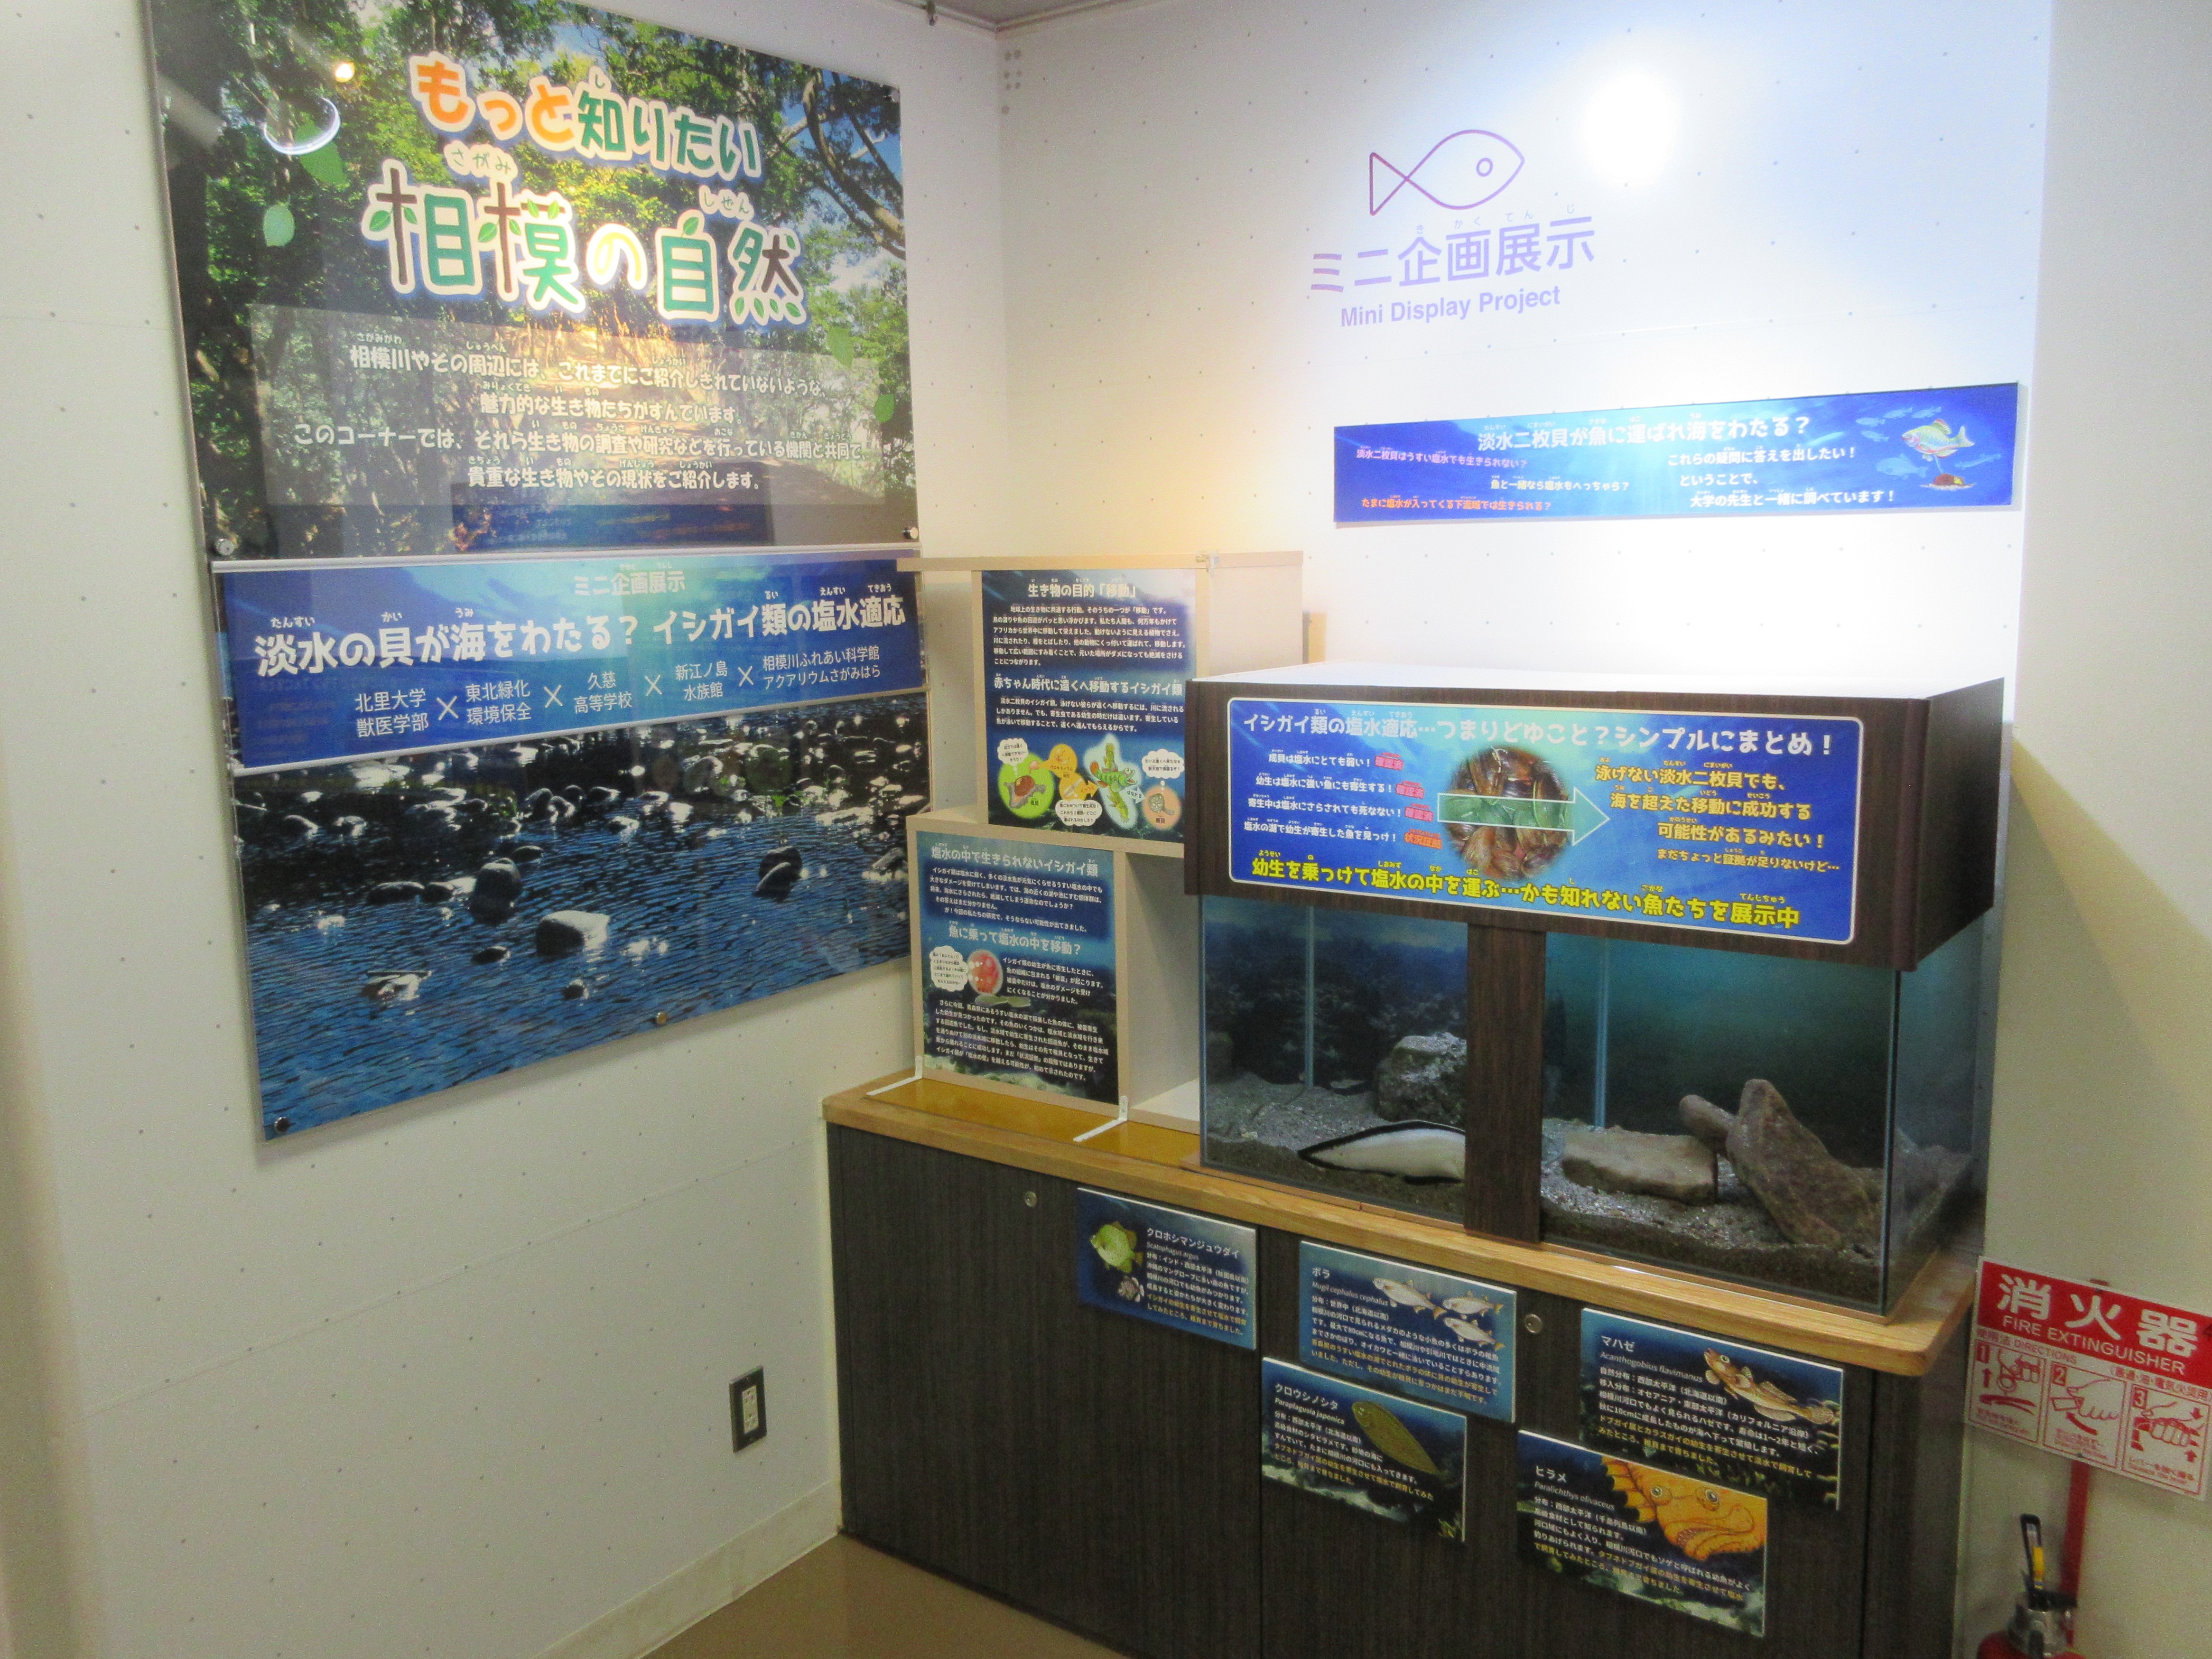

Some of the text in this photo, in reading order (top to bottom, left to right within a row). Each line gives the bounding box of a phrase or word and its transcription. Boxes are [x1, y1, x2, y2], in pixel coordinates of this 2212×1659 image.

[416, 60, 761, 176] もっと知りたい
[450, 146, 512, 173] さがみ
[704, 190, 751, 215] しぜん
[368, 167, 801, 320] 相模の自然
[1311, 216, 1595, 292] ミニ企画展示
[1341, 286, 1561, 327] Mini Display Project
[356, 332, 402, 343] さがみがわ
[465, 341, 506, 353] しゅうへん
[483, 381, 531, 392] みりょくてき
[481, 392, 743, 423] 魅力的な生き物たちがすんでいます。
[1478, 416, 1810, 452] 淡水二枚貝が魚に運ばれ海をわたる？
[1356, 448, 1527, 469] 淡水二枚貝はうすい塩水でも生きられない？
[1668, 447, 1856, 466] これらの疑問に答えを出したい！
[467, 466, 759, 490] 貴重な生き物やその現状をご紹介します。
[1491, 479, 1629, 492] 魚と一緒なら塩水もへっちゃら？
[1679, 473, 1758, 486] ということで、
[1690, 489, 1896, 507] 大学の先生と一緒に調べています！
[575, 570, 685, 596] ミニ企画展示
[1028, 583, 1136, 598] 生き物の目的「移動」
[271, 616, 316, 629] たんすい
[381, 611, 402, 623] かい
[456, 607, 474, 618] うみ
[254, 594, 906, 677] 淡水の貝が海をわたる？ イシガイ類の塩水適応
[355, 645, 880, 713] 北里大学 東北緑化 久慈 新江ノ島 相模川ふれあい科学館
[994, 677, 1182, 696] 赤ちゃん時代に遠くへ移動するイシガイ類
[356, 664, 881, 737] 獣医学部 環境保全 高等学校 水族館 アクアリウムさがみはら
[1244, 713, 1832, 756] イシガイ類の塩水適応…つまりどゆこと？シンプルにまとめ！
[1268, 753, 1371, 767] 成貝は塩水にとても弱い！
[1255, 776, 1392, 793] 幼生は塩水に強い魚にも寄生する！
[1596, 766, 1785, 791] 泳げない淡水二枚貝でも、
[1248, 798, 1402, 818] 寄生中は塩水にさらされても死なない！
[1610, 792, 1812, 821] 海を超えた移動に成功する
[1244, 821, 1396, 842] 塩水の湖で幼生が寄生した魚を見つけ！
[1657, 822, 1825, 848] 可能性があるみたい！
[931, 846, 1098, 877] 塩水の中で生きられないイシガイ類
[1657, 848, 1840, 872] まだちょっと証拠が足りないけど…
[1252, 856, 1800, 929] 幼生を乗っけて塩水の中を運ぶ…かも知れない魚たちを展示中
[949, 925, 1081, 956] 魚に乗って塩水の中を移動？
[1147, 1228, 1239, 1259] クロホシマンジュウダイ
[1312, 1267, 1330, 1278] ボラ
[1997, 1273, 2198, 1358] 消火器
[1601, 1335, 1635, 1353] マハゼ
[2003, 1315, 2186, 1375] FIRE EXTINGUISHER
[2013, 1338, 2078, 1364] DIRECTIONS
[2054, 1367, 2065, 1385] 2
[1275, 1383, 1338, 1410] クロウシノシタ
[2136, 1389, 2145, 1403] 3
[1275, 1397, 1345, 1425] Paraplagusia japonica
[1535, 1466, 1567, 1483] ヒラメ
